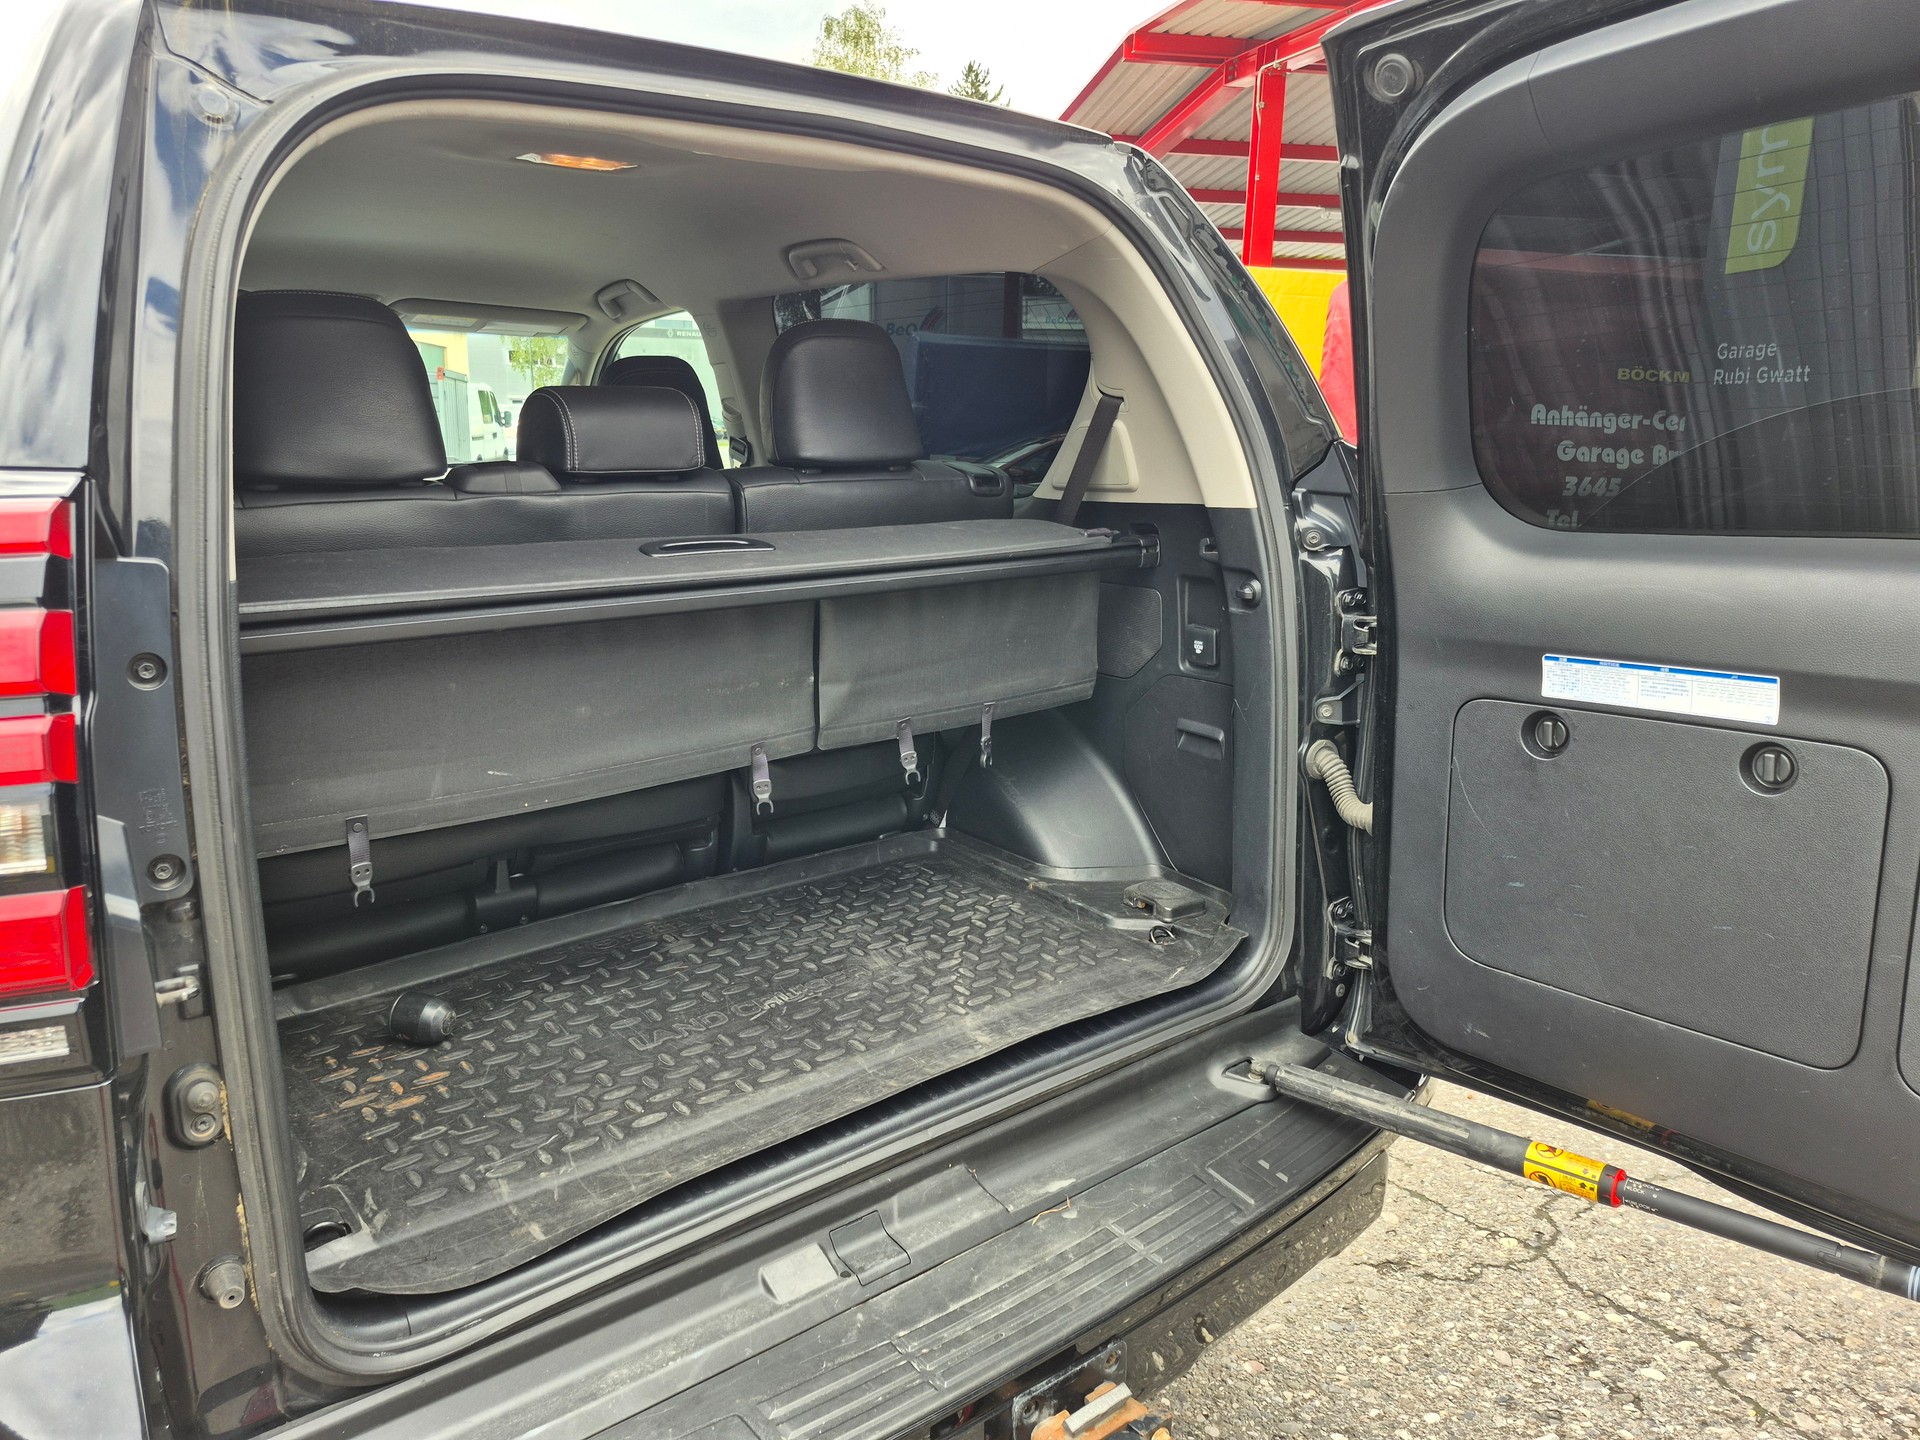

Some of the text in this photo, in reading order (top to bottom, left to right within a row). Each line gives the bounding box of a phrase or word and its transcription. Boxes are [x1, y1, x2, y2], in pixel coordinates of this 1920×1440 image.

[1717, 342, 1778, 361] Garage
[1617, 366, 1691, 383] BÖCKM
[1713, 365, 1811, 385] Rubi Gwatt
[1556, 440, 1645, 470] Garage
[1562, 476, 1622, 497] 3645
